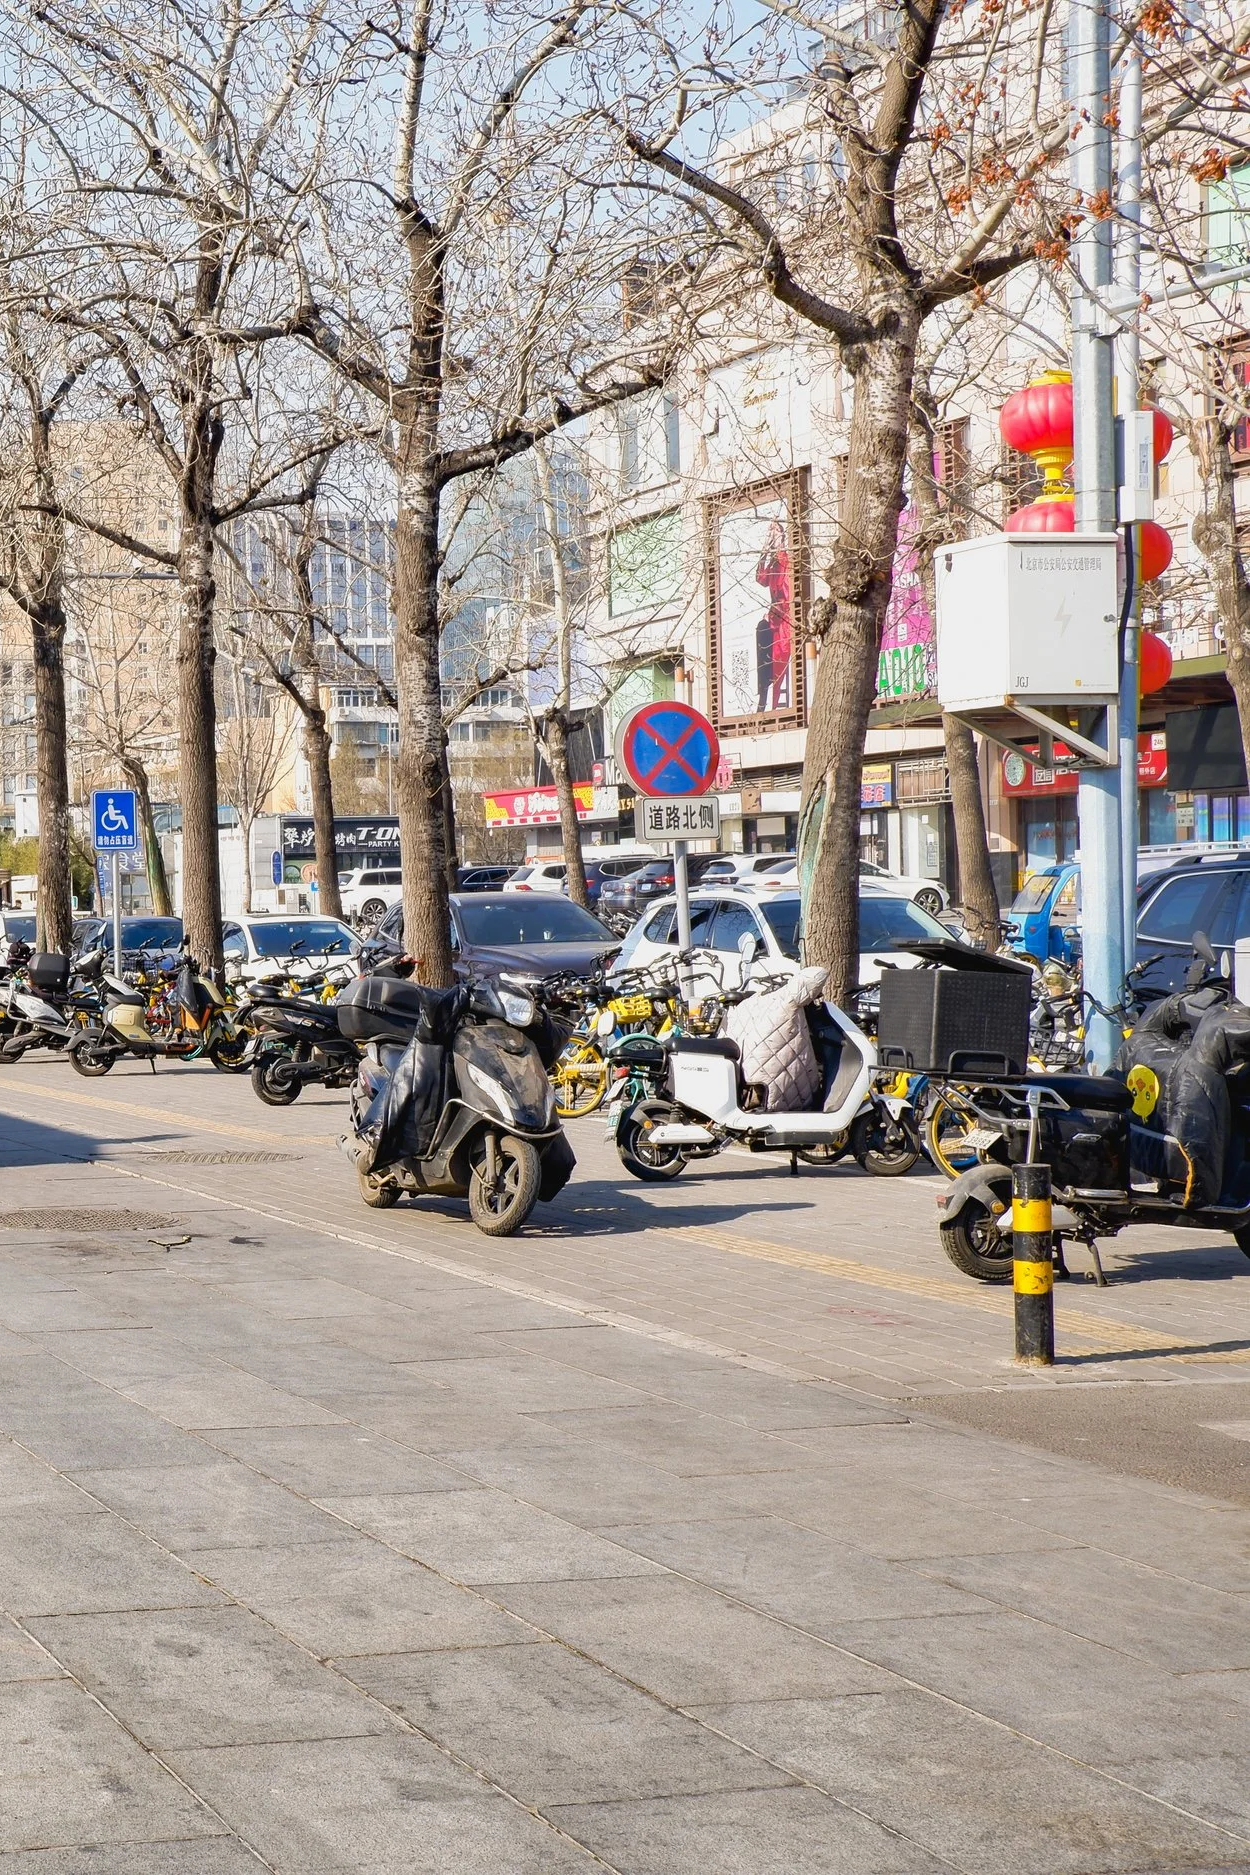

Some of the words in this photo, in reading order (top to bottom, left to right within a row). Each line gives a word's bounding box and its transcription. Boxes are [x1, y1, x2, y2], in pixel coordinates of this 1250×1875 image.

[1015, 676, 1029, 688] JGJ
[649, 804, 714, 830] 道路北侧
[356, 826, 400, 841] T-ON
[97, 835, 133, 846] 请勿占压盲道
